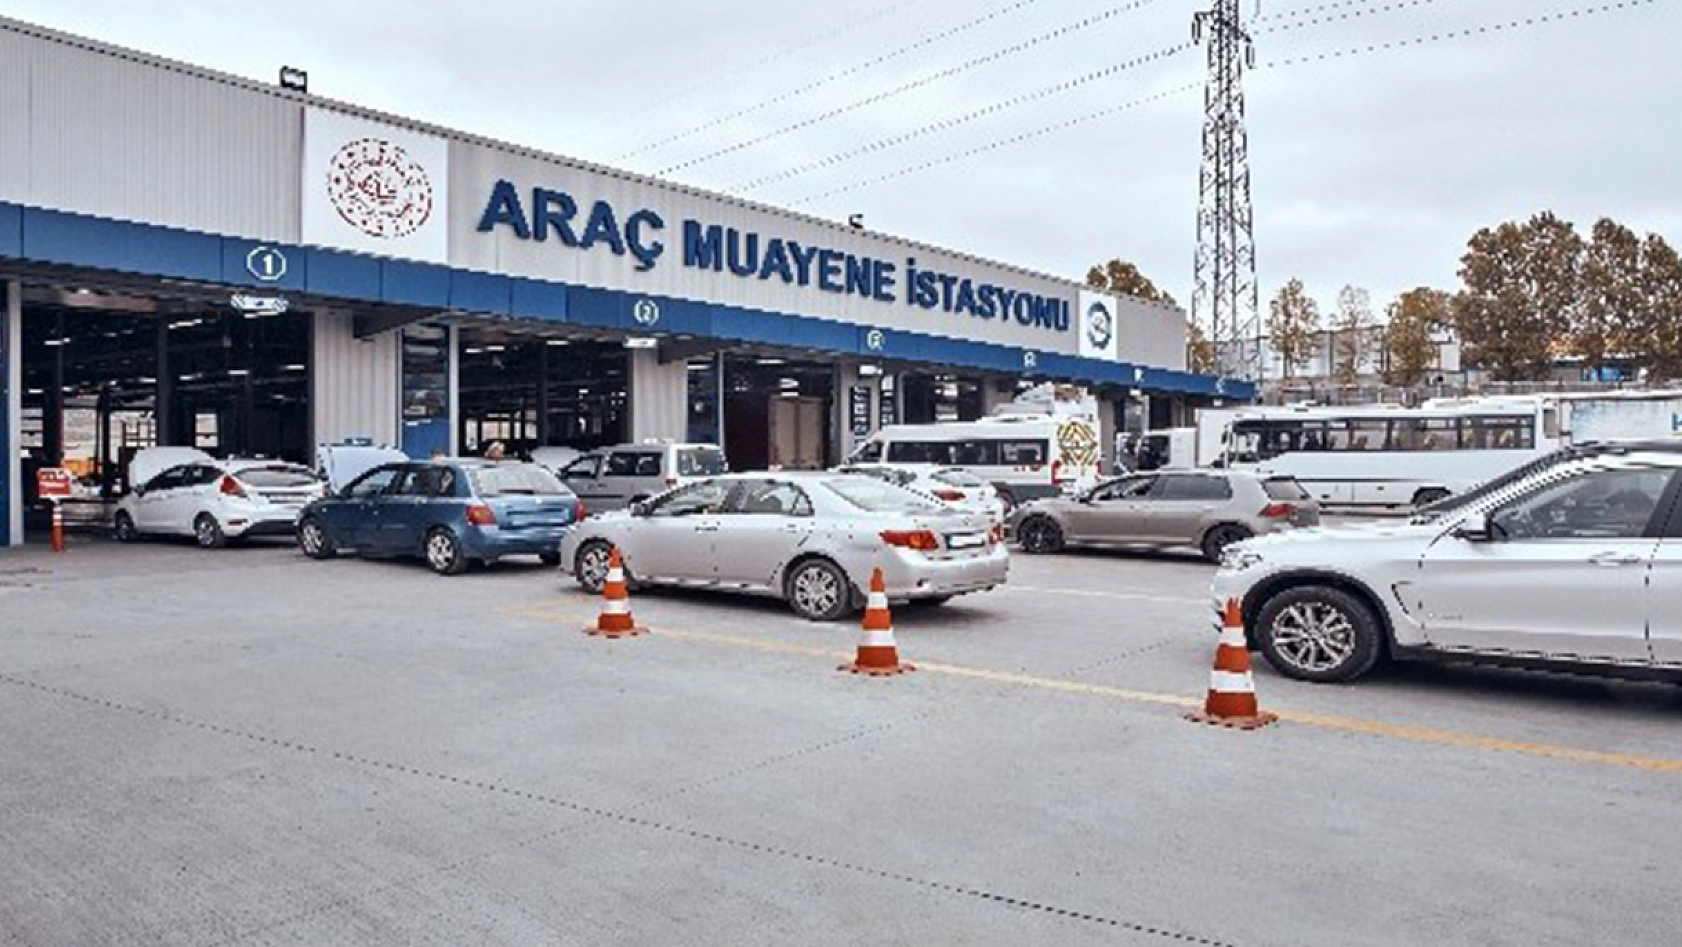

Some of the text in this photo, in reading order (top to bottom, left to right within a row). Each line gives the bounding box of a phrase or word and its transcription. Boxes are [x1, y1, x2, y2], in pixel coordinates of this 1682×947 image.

[263, 253, 273, 275] 1
[477, 179, 665, 271] ARAÇ
[683, 220, 896, 303] MUAYENE
[907, 257, 1070, 332] İSTASYONU
